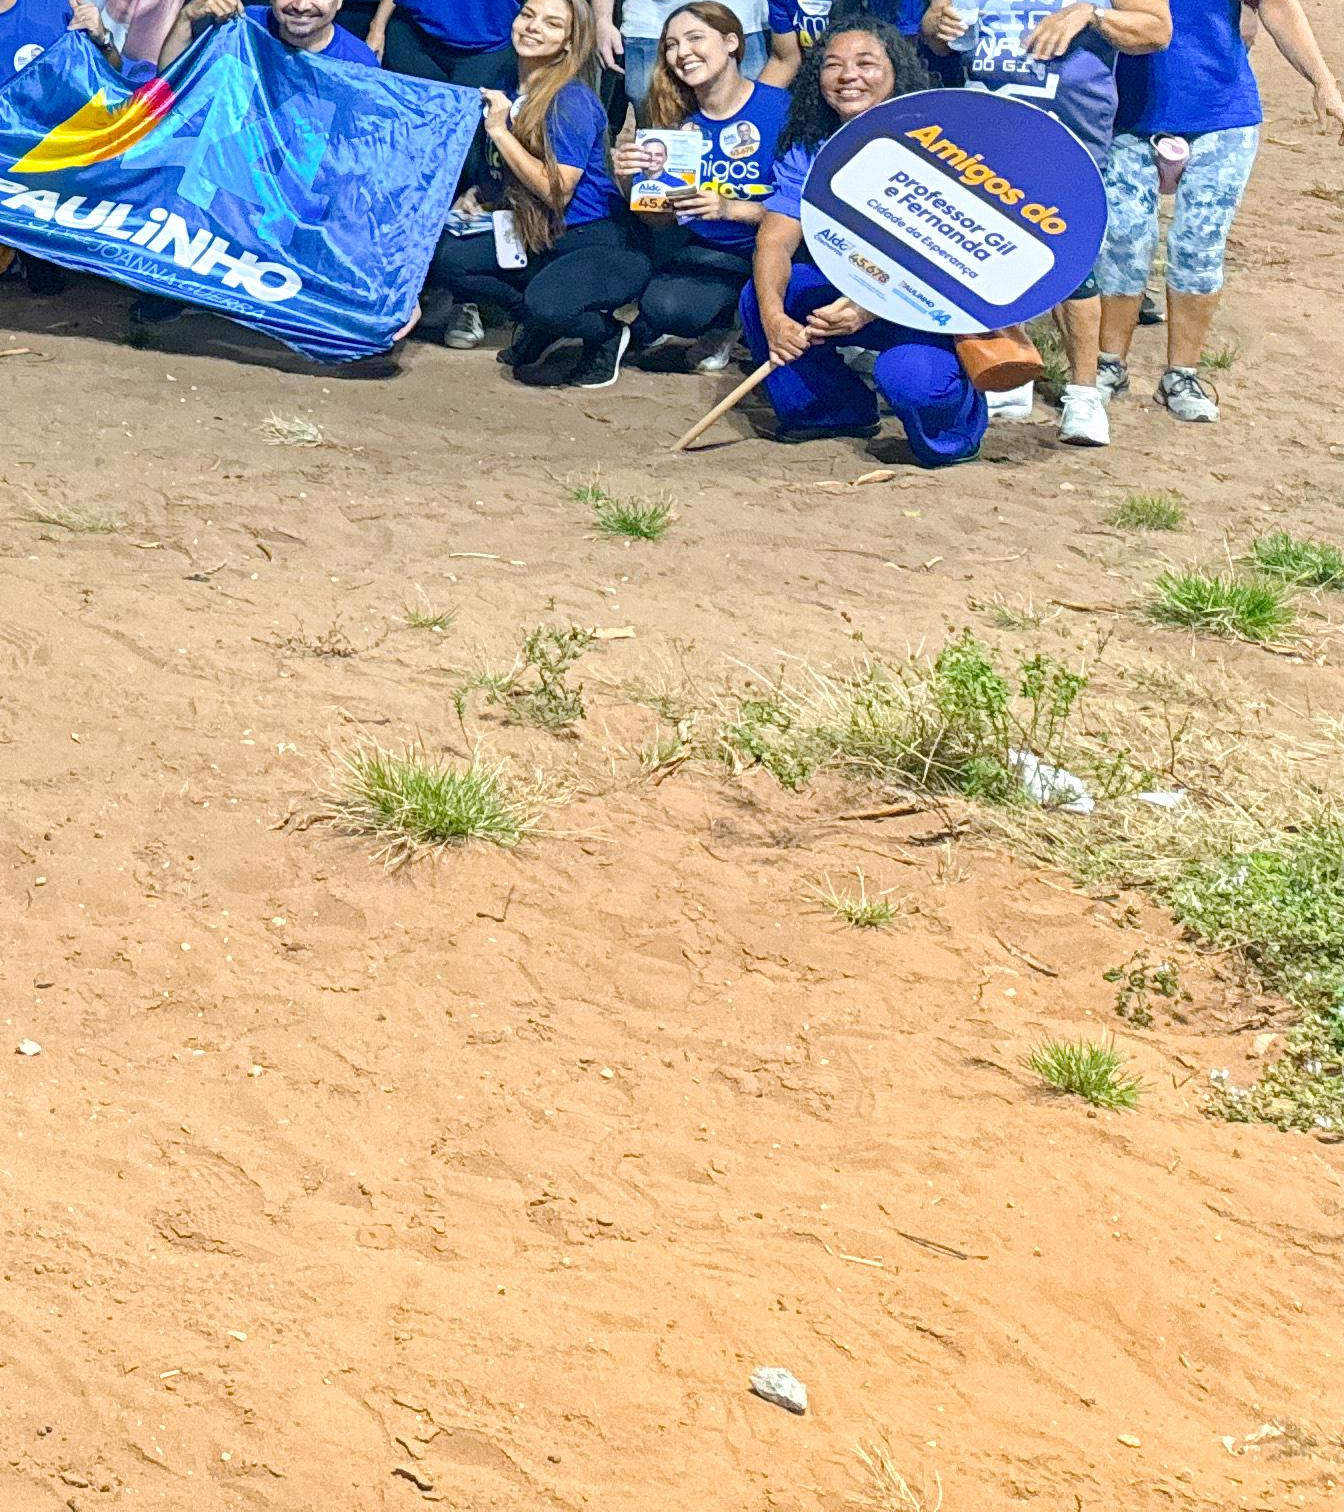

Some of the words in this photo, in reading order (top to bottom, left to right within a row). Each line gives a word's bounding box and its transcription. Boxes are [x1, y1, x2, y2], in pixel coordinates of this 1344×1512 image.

[638, 197, 674, 210] 45.6
[887, 169, 987, 237] professor
[983, 231, 1019, 257] Gil
[903, 124, 1026, 206] Amigos
[1020, 202, 1068, 236] do
[866, 197, 908, 229] Cidade
[905, 223, 923, 240] da
[921, 235, 980, 281] Esperança
[883, 185, 900, 199] e
[898, 193, 993, 263] Fernanda
